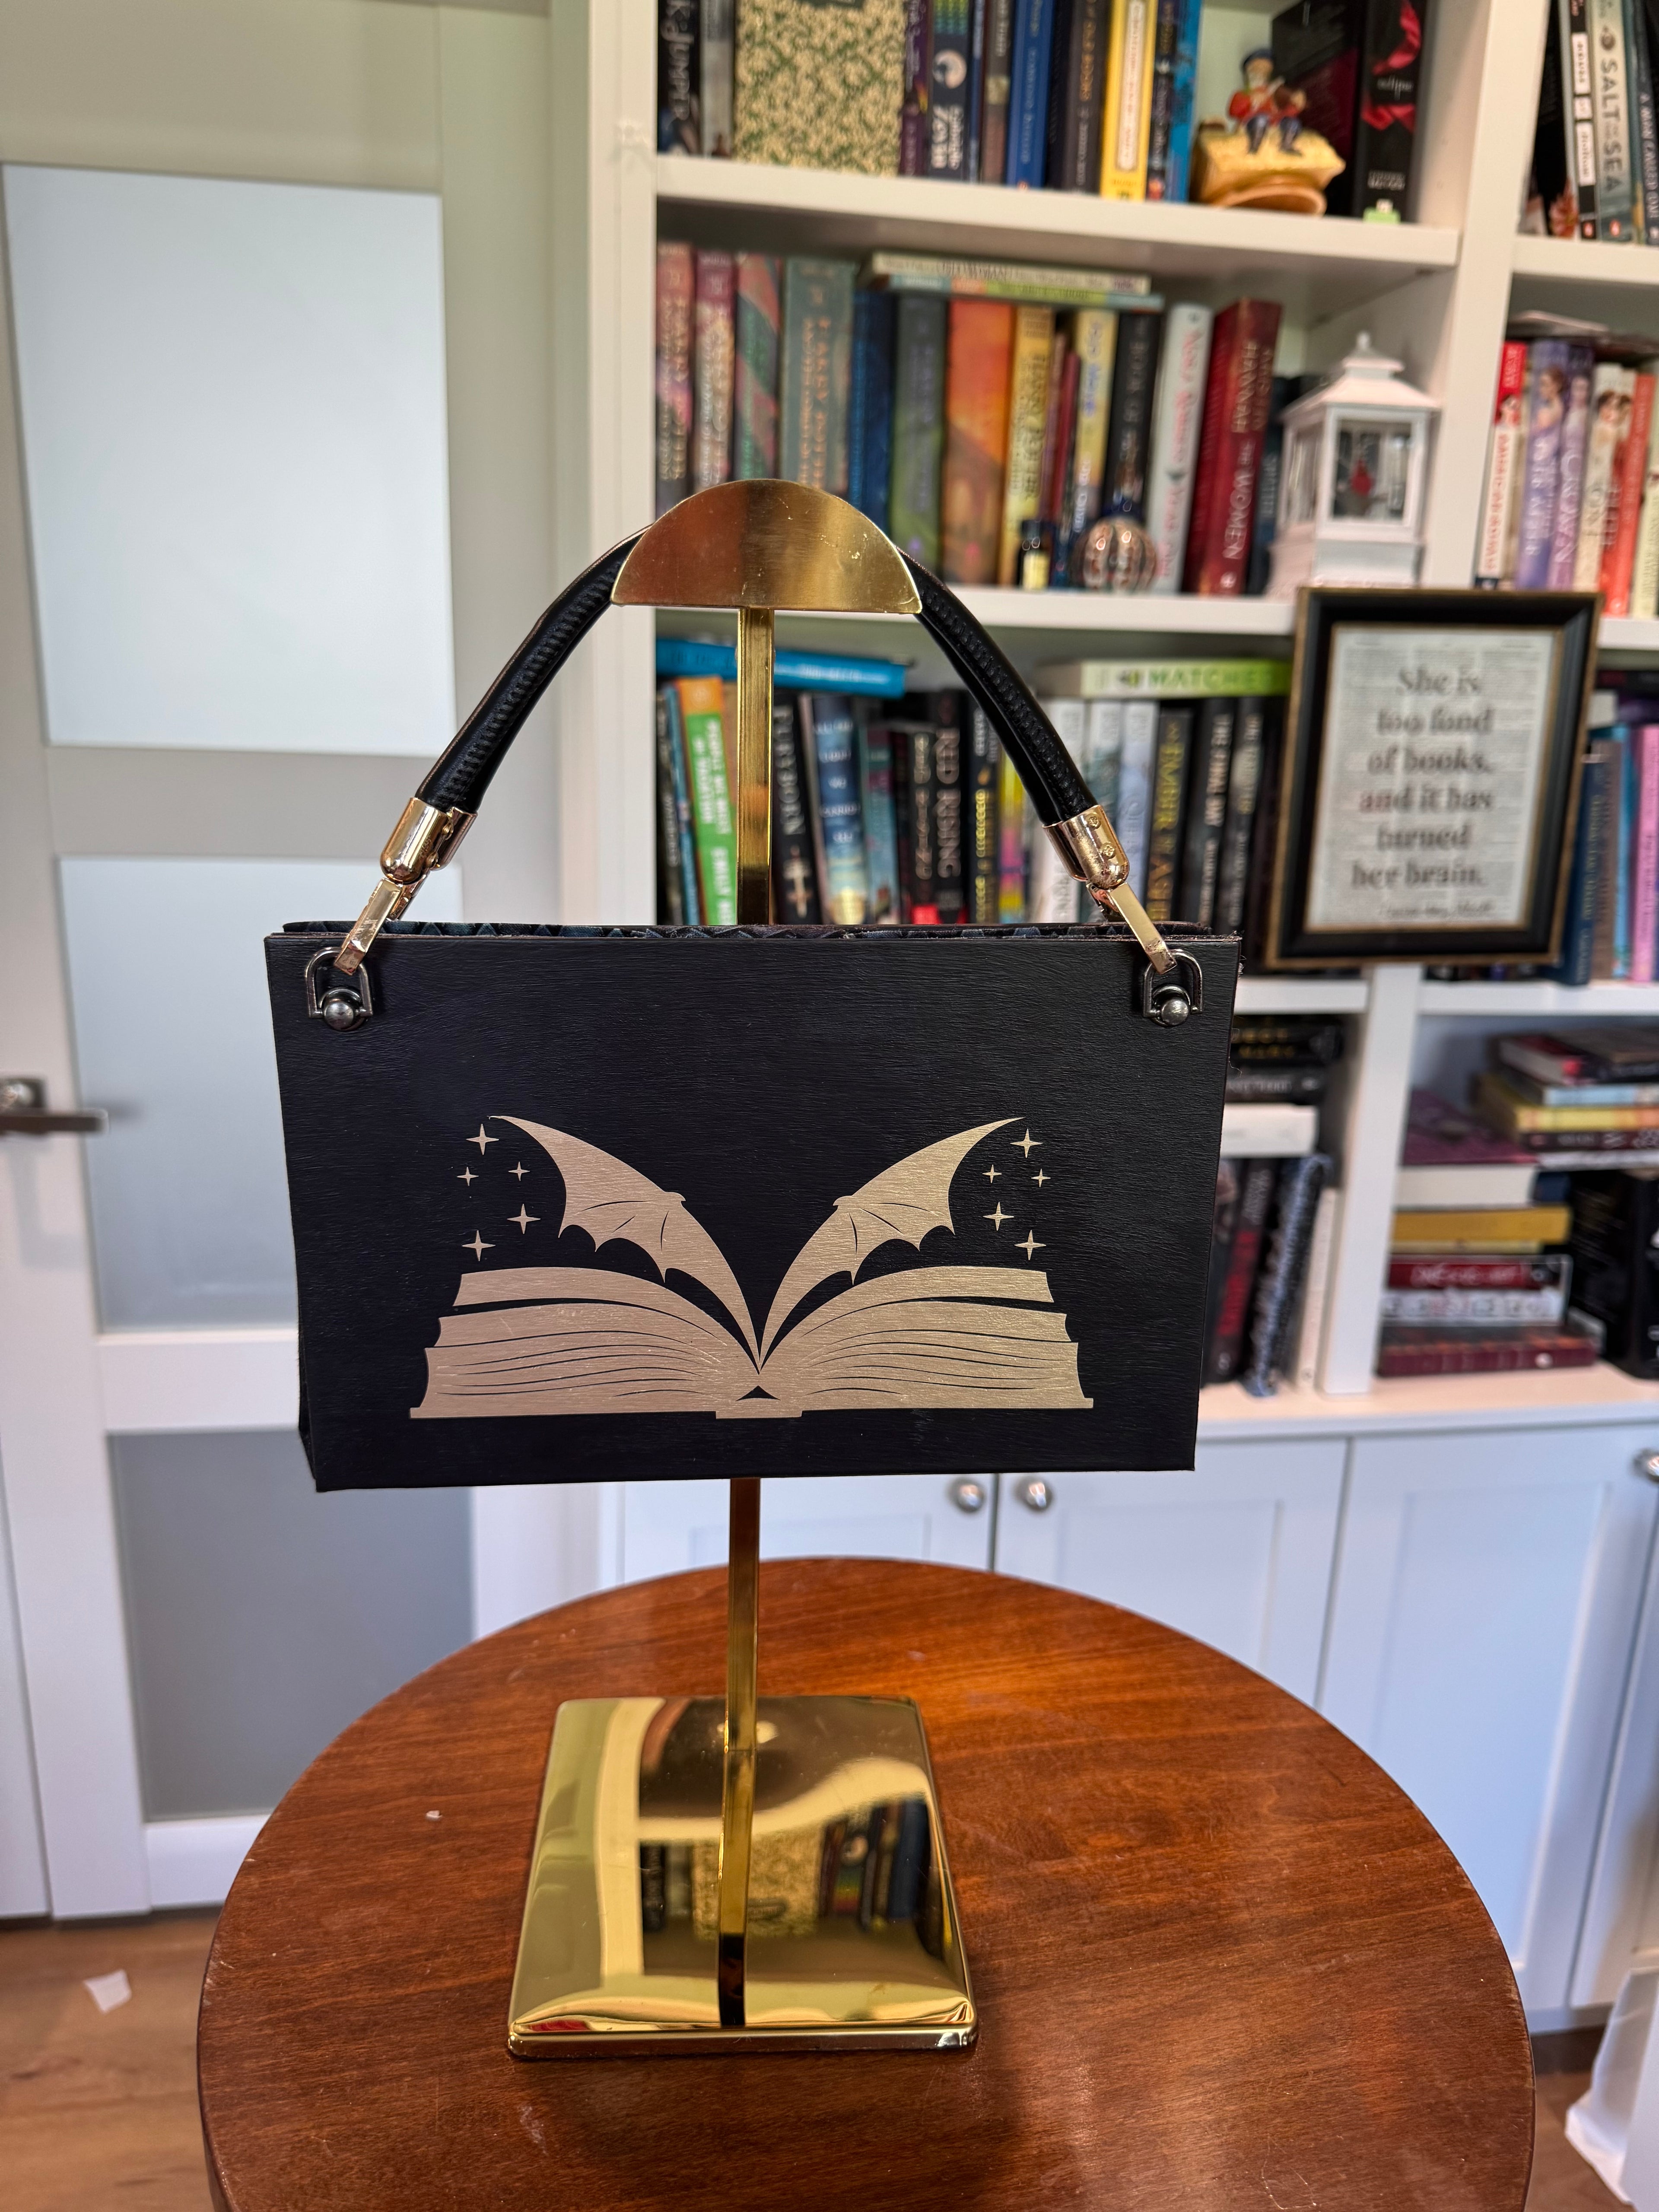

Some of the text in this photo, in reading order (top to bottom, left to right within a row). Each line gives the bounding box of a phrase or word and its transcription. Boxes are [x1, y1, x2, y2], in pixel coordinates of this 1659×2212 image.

[1600, 59, 1621, 124] SALT
[1641, 107, 1654, 139] MAN
[1603, 140, 1622, 191] SEA
[1231, 341, 1259, 433] HANNAH
[1221, 469, 1253, 560] WOMEN
[1554, 448, 1582, 563] CROWN
[1397, 667, 1482, 693] She is
[1376, 706, 1494, 735] too fond
[1205, 714, 1233, 827] THE FINAL DAY
[1367, 743, 1400, 775] of
[914, 735, 932, 880] RED RISING
[933, 728, 960, 878] RED RISING
[1154, 743, 1184, 830] EMBER
[1358, 783, 1494, 813] and it has
[715, 798, 732, 835] MEET
[1376, 822, 1471, 851] turned
[711, 847, 731, 896] EMILY
[1351, 861, 1402, 890] her
